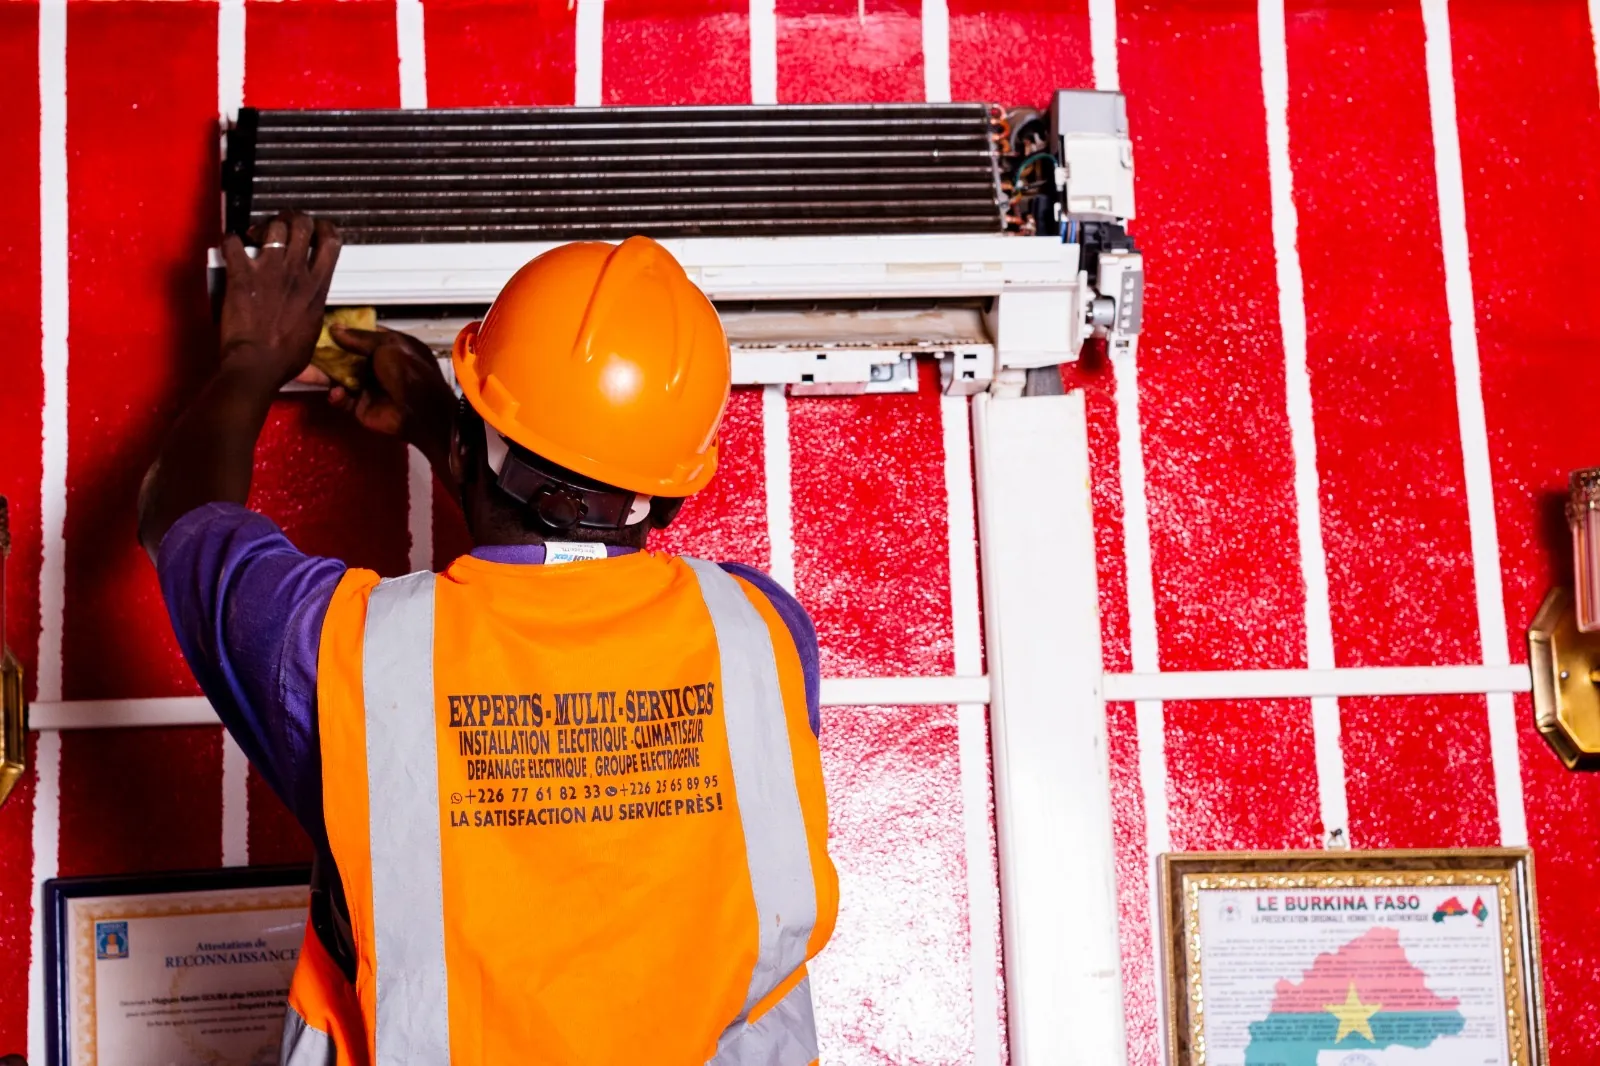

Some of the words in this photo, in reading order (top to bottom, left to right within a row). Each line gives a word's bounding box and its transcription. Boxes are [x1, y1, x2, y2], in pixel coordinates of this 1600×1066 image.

[459, 729, 550, 756] INSTALLATION
[467, 758, 526, 780] DEPANAGE
[595, 754, 639, 777] GROUPE
[640, 747, 700, 772] ELECTROGENE
[465, 788, 504, 804] +226
[511, 787, 529, 802] 77
[536, 786, 552, 801] 61
[559, 786, 577, 800] 82
[584, 784, 601, 799] 33
[620, 781, 651, 797] +226
[656, 780, 667, 794] 25
[670, 778, 682, 792] 65
[687, 776, 700, 790] 89
[704, 775, 718, 788] 95
[450, 810, 470, 828] LA
[474, 806, 586, 828] SATISFACTION
[591, 804, 614, 822] AU
[618, 799, 673, 821] SERVICE
[1256, 896, 1278, 911] LE
[1285, 895, 1368, 911] BURKINA
[1374, 895, 1421, 910] FASO
[165, 948, 298, 968] RECONNAISSANCE
[196, 940, 252, 952] Attestation
[253, 938, 267, 948] de
